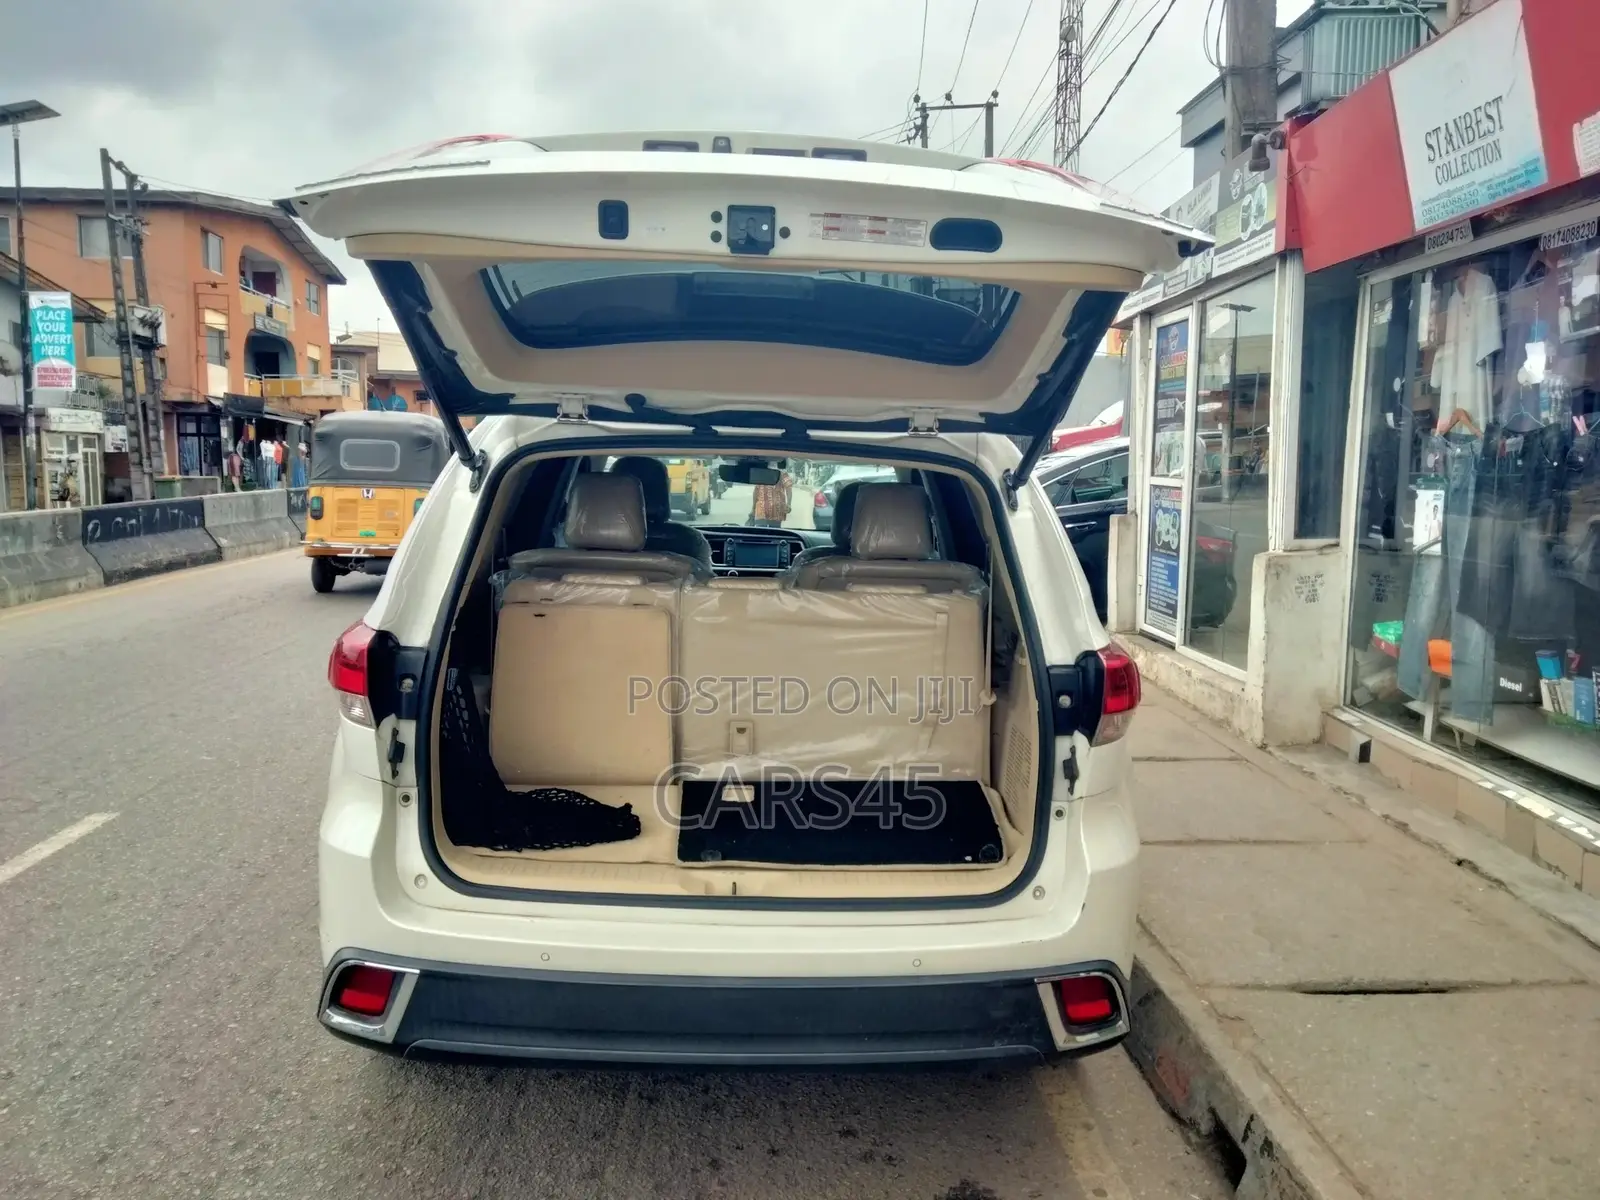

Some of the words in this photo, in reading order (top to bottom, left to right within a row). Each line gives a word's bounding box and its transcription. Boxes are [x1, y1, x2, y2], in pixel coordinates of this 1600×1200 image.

[1424, 95, 1505, 163] STANBEST
[1435, 138, 1503, 186] COLLECTION
[1541, 220, 1596, 250] 08174088230
[36, 310, 66, 321] PLACE
[37, 321, 66, 333] YOUR
[34, 333, 72, 345] ADVERT
[41, 345, 66, 356] HERE
[1500, 677, 1522, 692] Diesel
